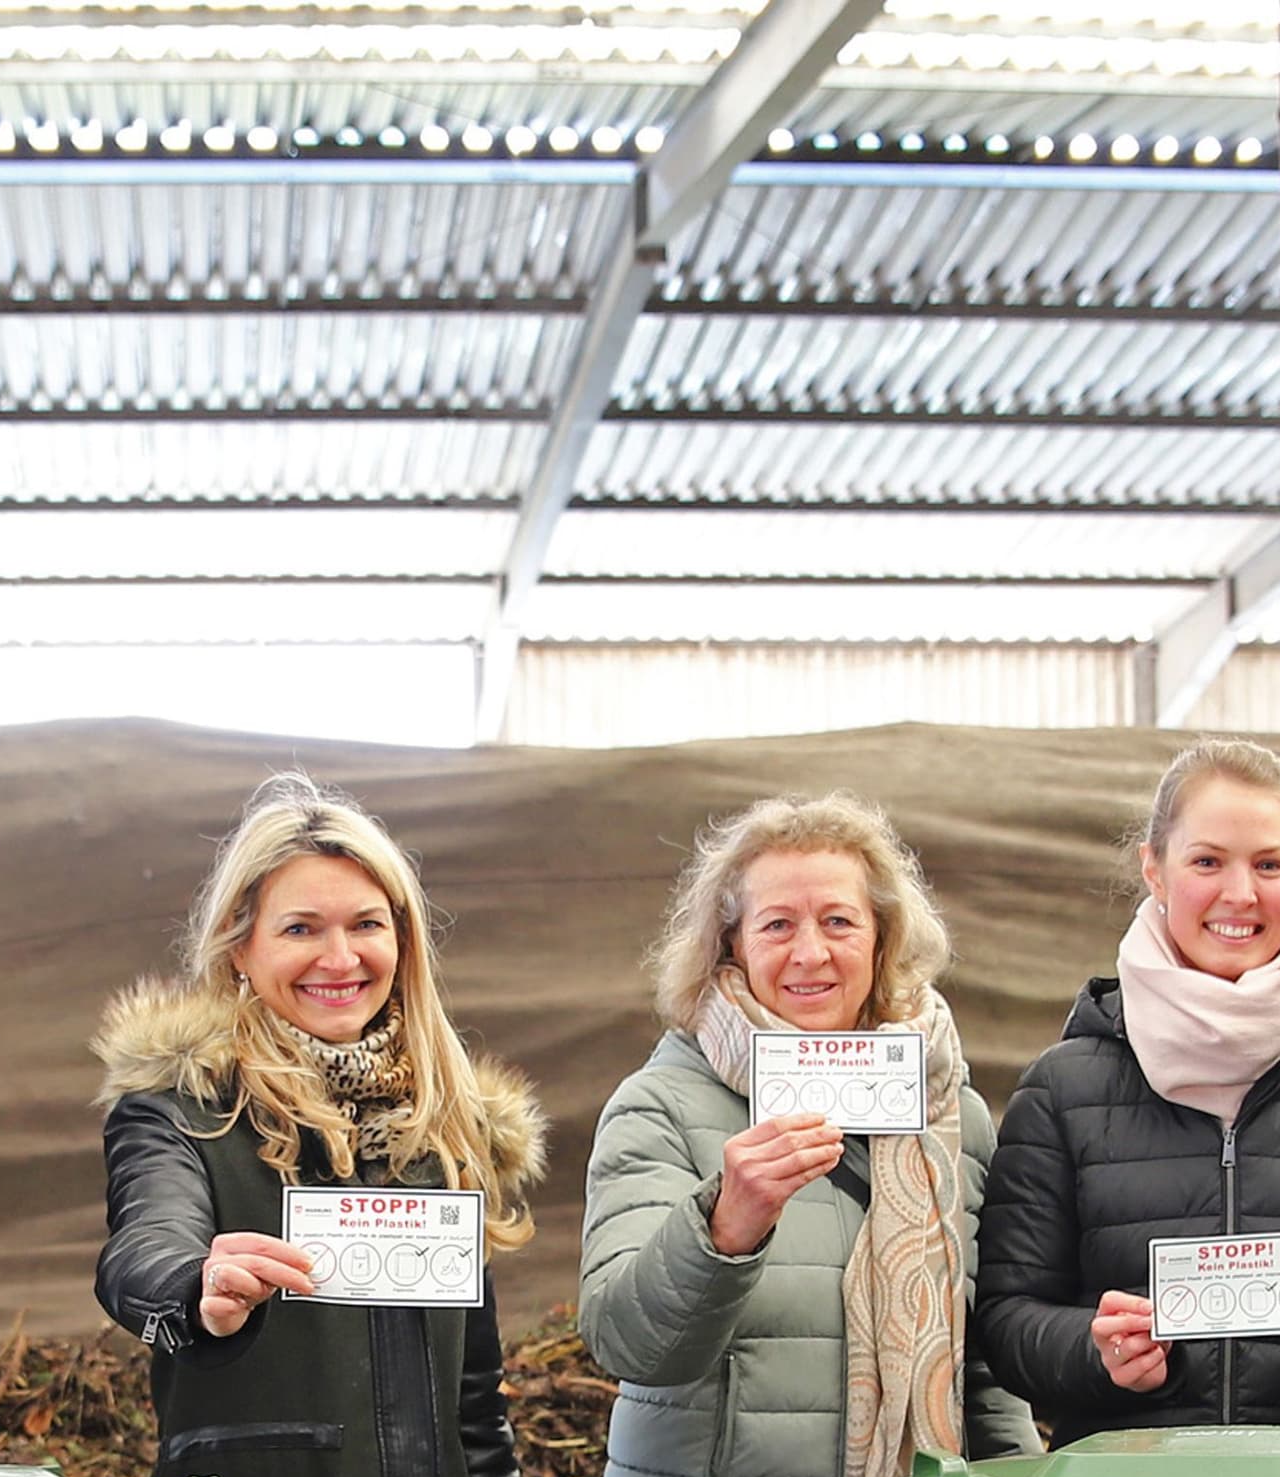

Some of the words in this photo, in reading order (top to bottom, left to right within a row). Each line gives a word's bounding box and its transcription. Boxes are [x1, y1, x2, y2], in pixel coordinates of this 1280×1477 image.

[799, 1041, 874, 1054] STOPP!
[798, 1058, 825, 1066] Kein
[828, 1058, 874, 1067] Plastik!
[340, 1198, 426, 1214] STOPP!
[339, 1218, 370, 1227] Kein
[375, 1218, 426, 1229] Plastik!
[1198, 1243, 1273, 1260] STOPP!
[1197, 1262, 1225, 1273] Kein
[1228, 1259, 1274, 1270] Plastik!
